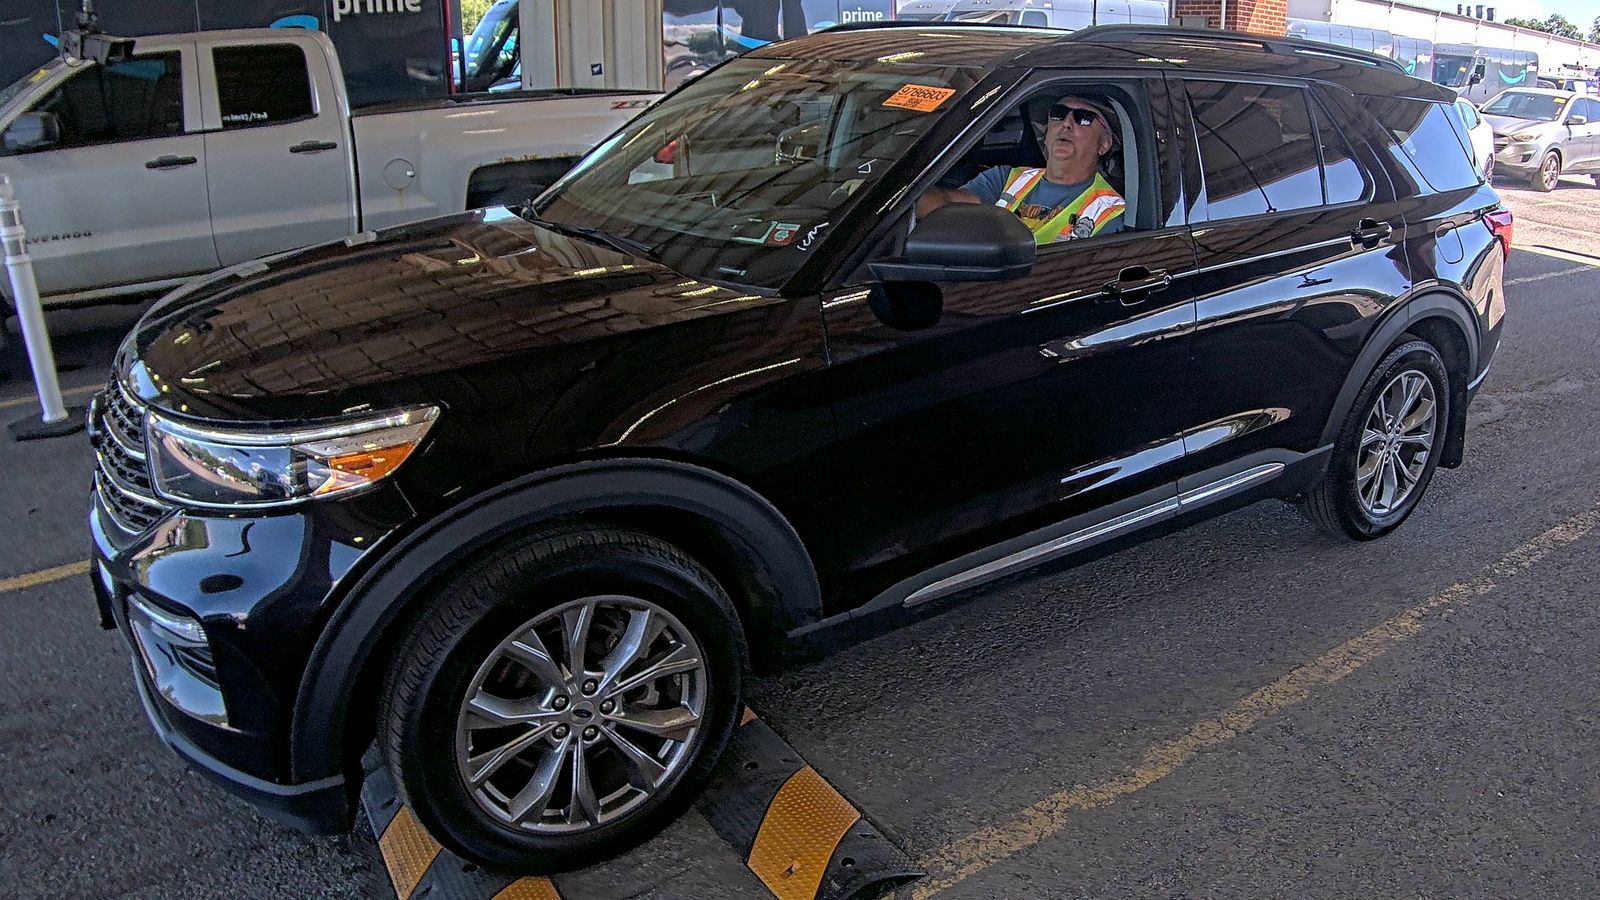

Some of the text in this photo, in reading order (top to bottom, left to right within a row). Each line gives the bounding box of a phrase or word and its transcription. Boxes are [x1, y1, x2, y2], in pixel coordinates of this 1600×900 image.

[842, 6, 883, 24] prime
[898, 86, 948, 101] 9786603
[24, 230, 92, 245] LVERADO
